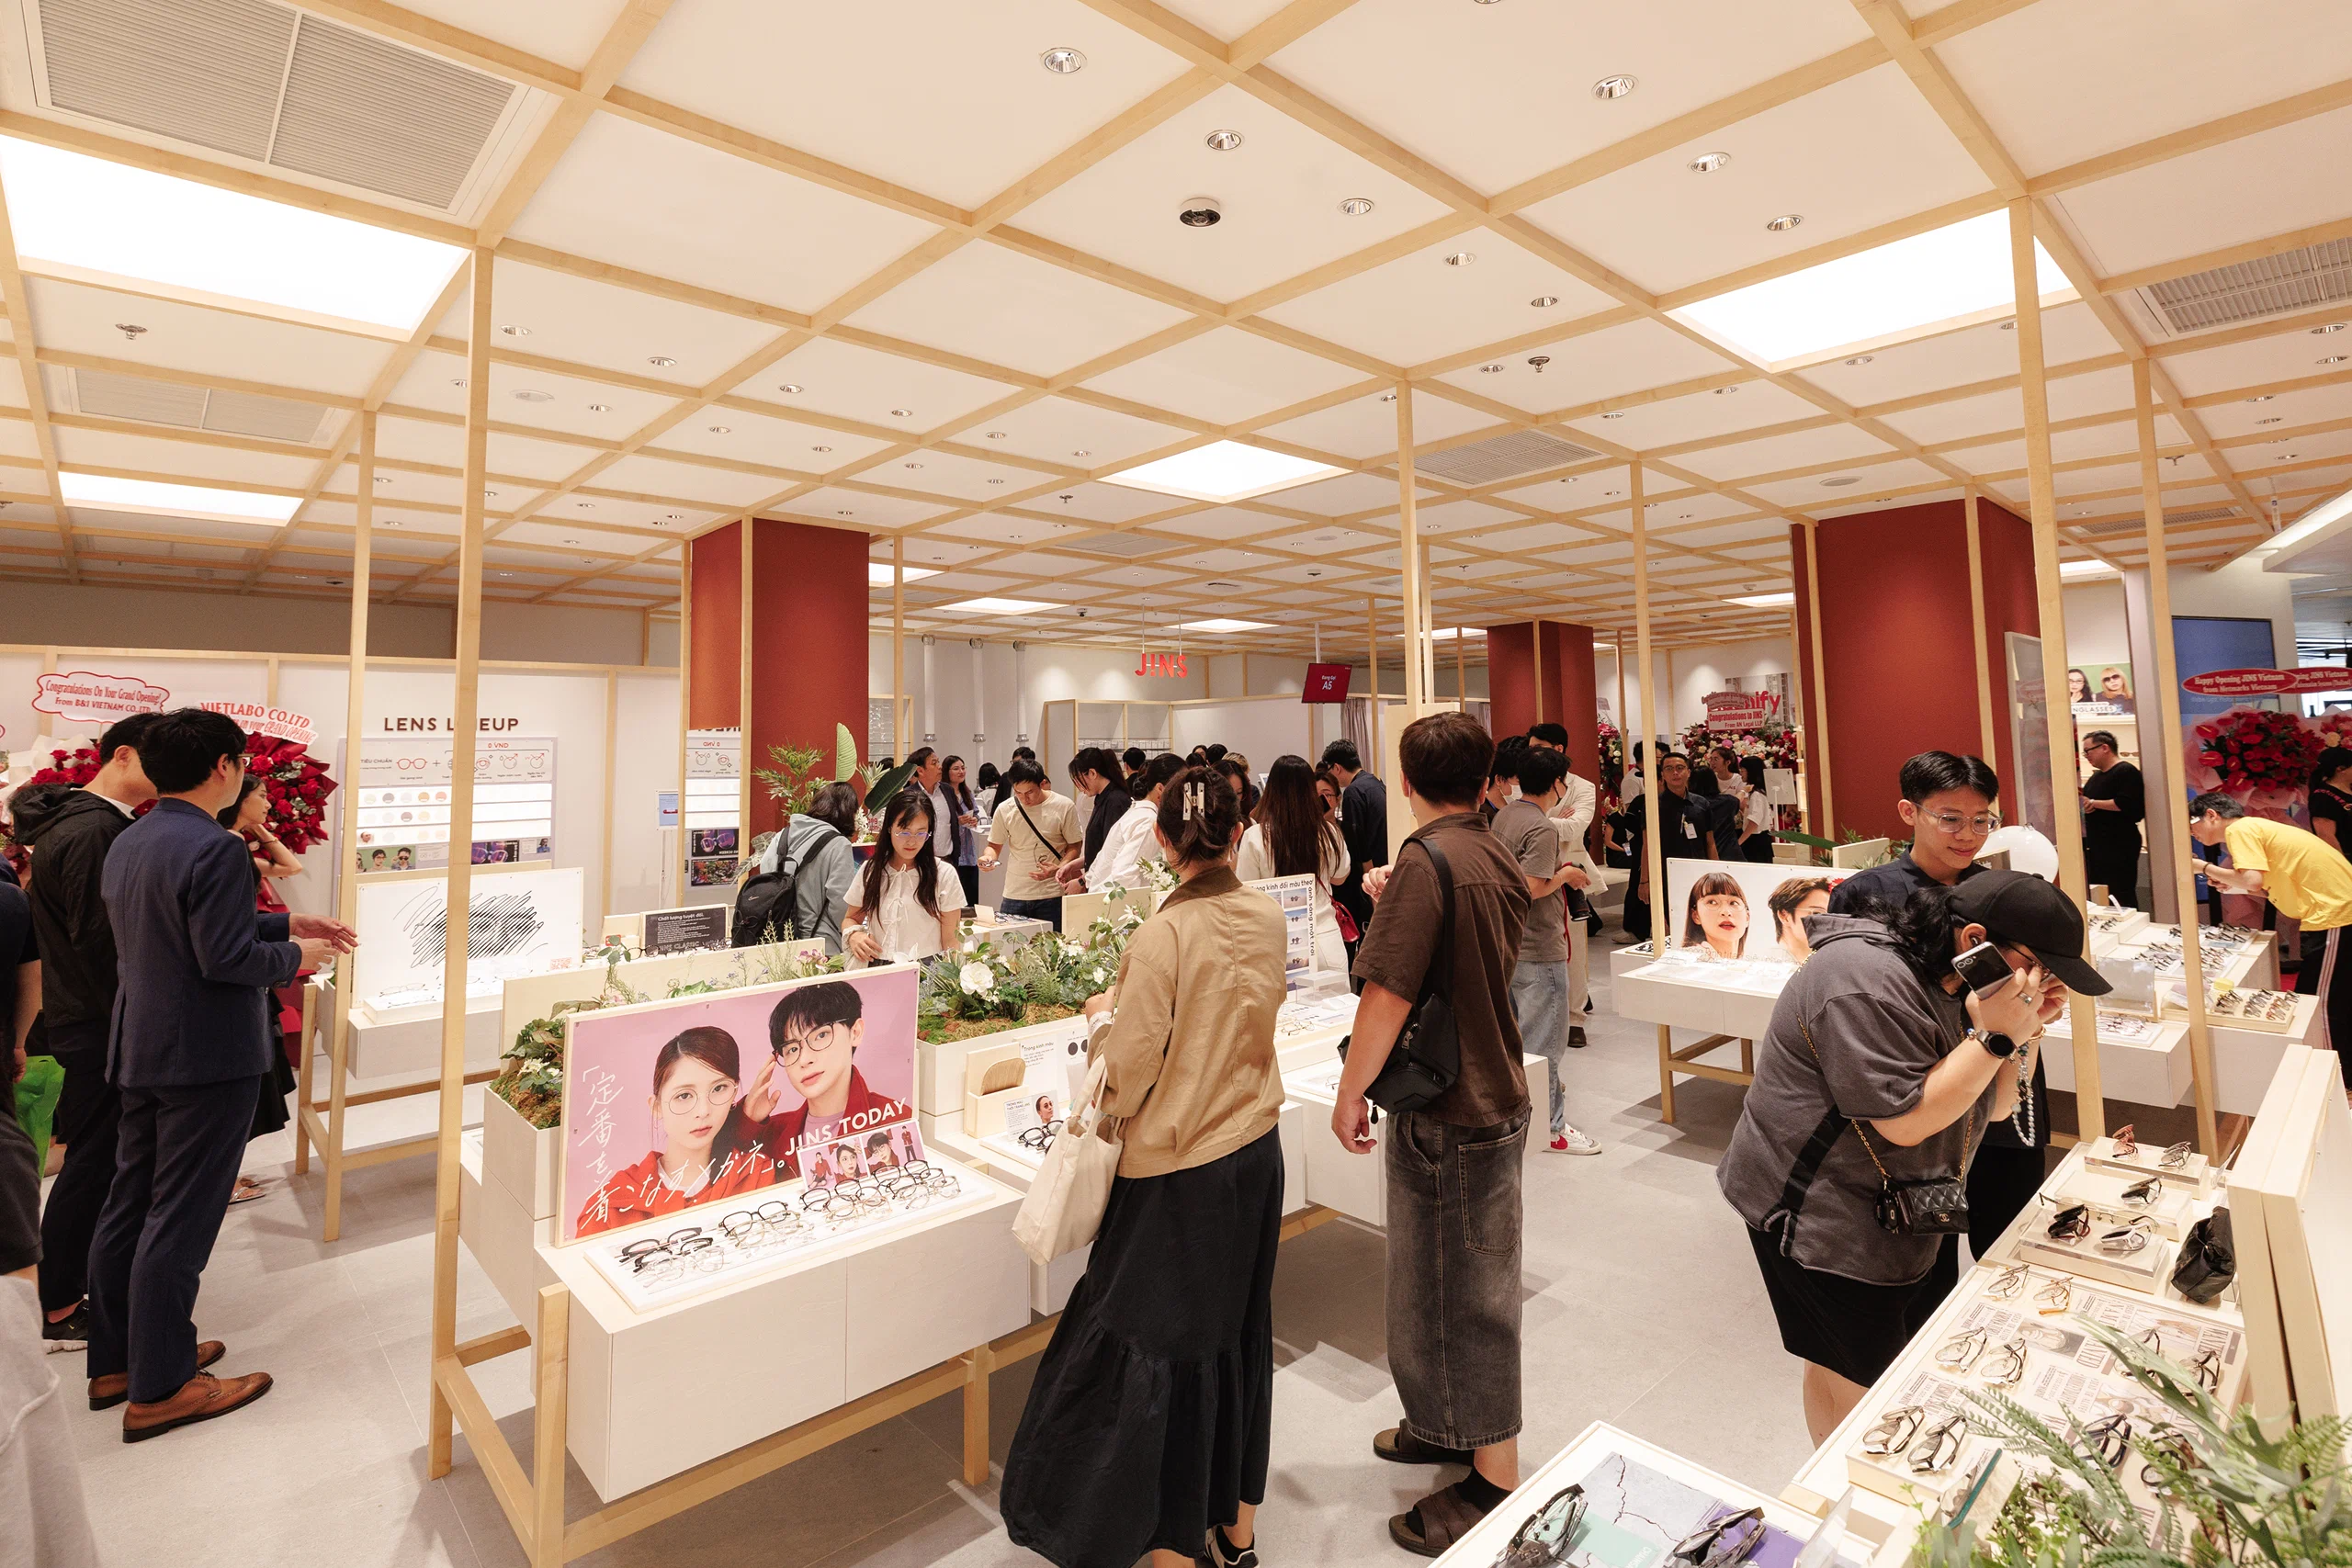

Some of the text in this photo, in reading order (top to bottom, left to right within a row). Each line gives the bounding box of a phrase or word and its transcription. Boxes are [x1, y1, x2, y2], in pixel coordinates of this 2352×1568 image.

[1322, 681, 1332, 690] A5
[2194, 673, 2285, 686] Happy Opening JINS Vietnam
[46, 680, 93, 696] Congratulations
[94, 685, 103, 697] On
[119, 688, 136, 701] Grand
[2251, 683, 2278, 692] Vietnam
[55, 696, 73, 705] From
[92, 701, 124, 712] VIETNAM
[200, 702, 265, 717] VIETLABO
[384, 717, 519, 731] LENS LEUP
[1709, 713, 1747, 723] Congratulations
[785, 1098, 907, 1156] JINS TODAY
[2076, 1336, 2108, 1369] ANTED
